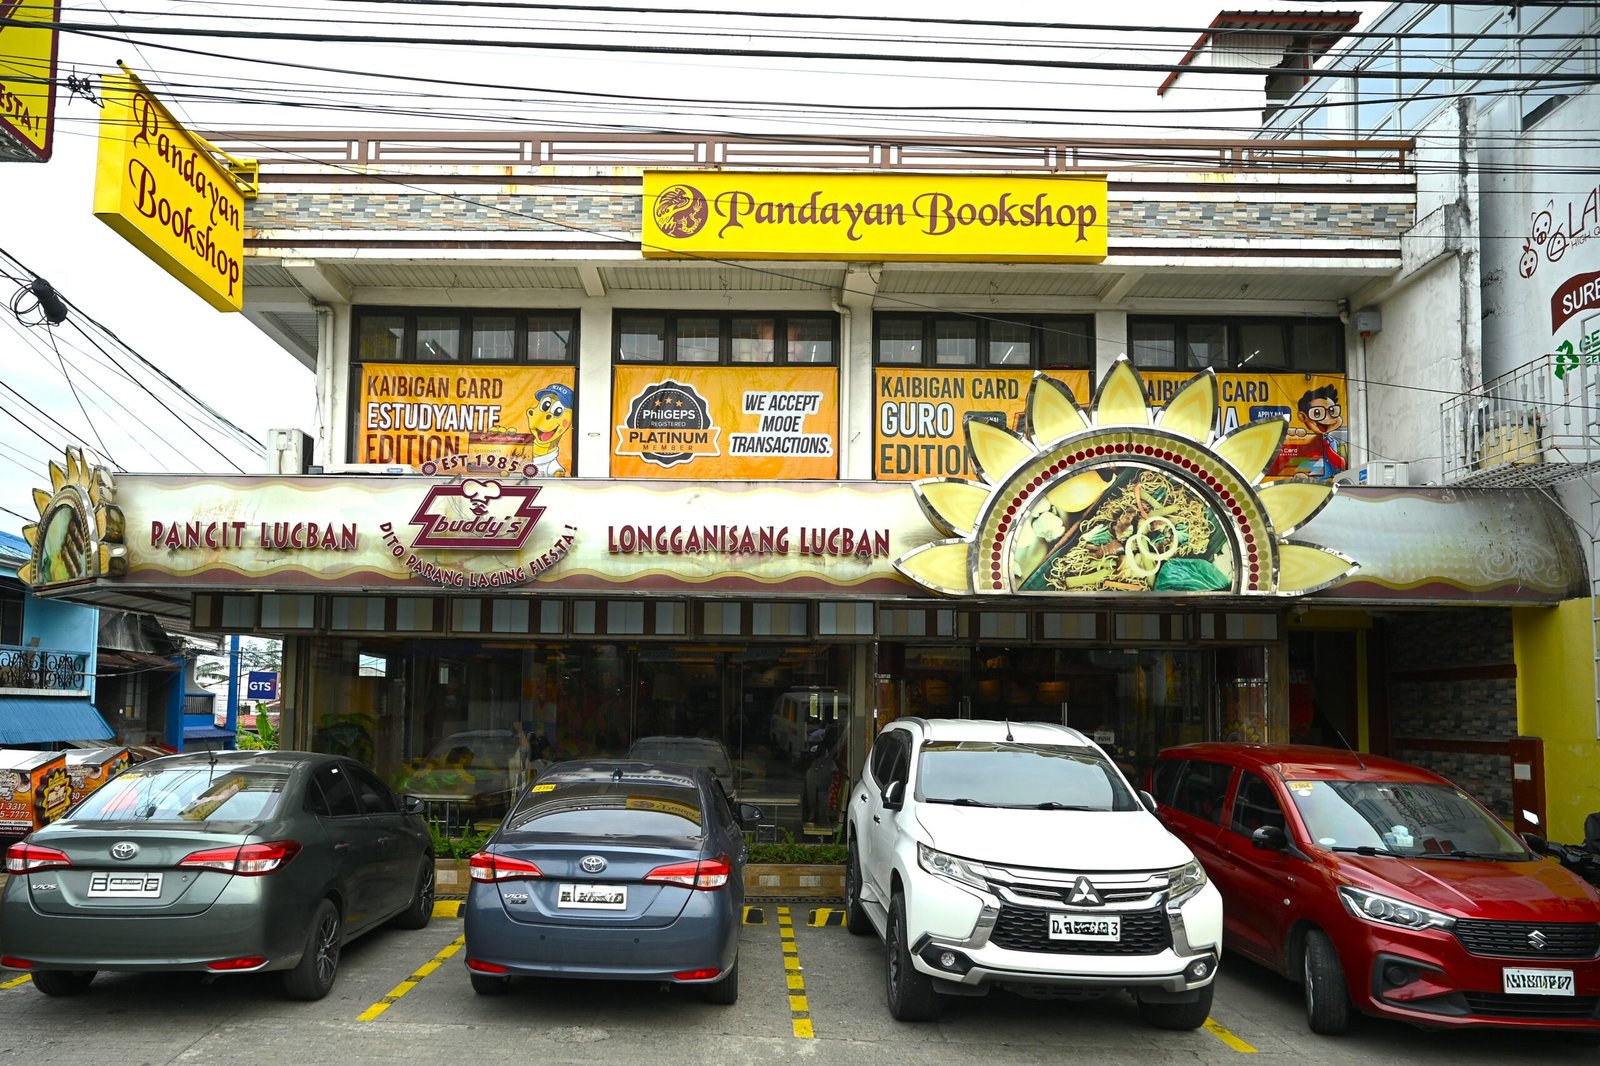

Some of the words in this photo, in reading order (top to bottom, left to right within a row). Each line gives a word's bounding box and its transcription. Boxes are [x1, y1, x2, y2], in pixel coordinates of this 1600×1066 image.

[133, 93, 240, 232] Pandayan
[129, 158, 240, 298] Bookshop
[714, 190, 906, 242] Pandayan
[913, 191, 1098, 243] Bookshop
[367, 375, 450, 398] KAIBIGAN
[456, 377, 503, 399] CARD
[880, 376, 965, 399] KAIBIGAN
[971, 377, 1019, 400] CARD
[1222, 380, 1270, 403] CARD
[642, 409, 696, 420] PhilGEPS
[745, 394, 765, 411] WE
[769, 394, 820, 411] ACCEPT
[366, 402, 502, 432] ESTUDYANTE
[761, 415, 802, 432] MOOE
[880, 401, 955, 439] GURO
[366, 434, 460, 464] EDITION
[629, 431, 708, 444] PLATINUM
[731, 436, 831, 454] TRANSACTIONS.
[442, 454, 468, 471] EST
[475, 454, 519, 472] 1985
[151, 520, 247, 549] PANCIT
[260, 521, 358, 550] LUCBAN
[433, 515, 522, 539] buddy's
[608, 525, 790, 553] LONGGANISANG
[800, 526, 890, 556] LUCBAN
[379, 521, 405, 558] DITO
[405, 554, 463, 587] PARANG
[469, 567, 526, 588] LAGING
[529, 524, 578, 576] FIESTA!
